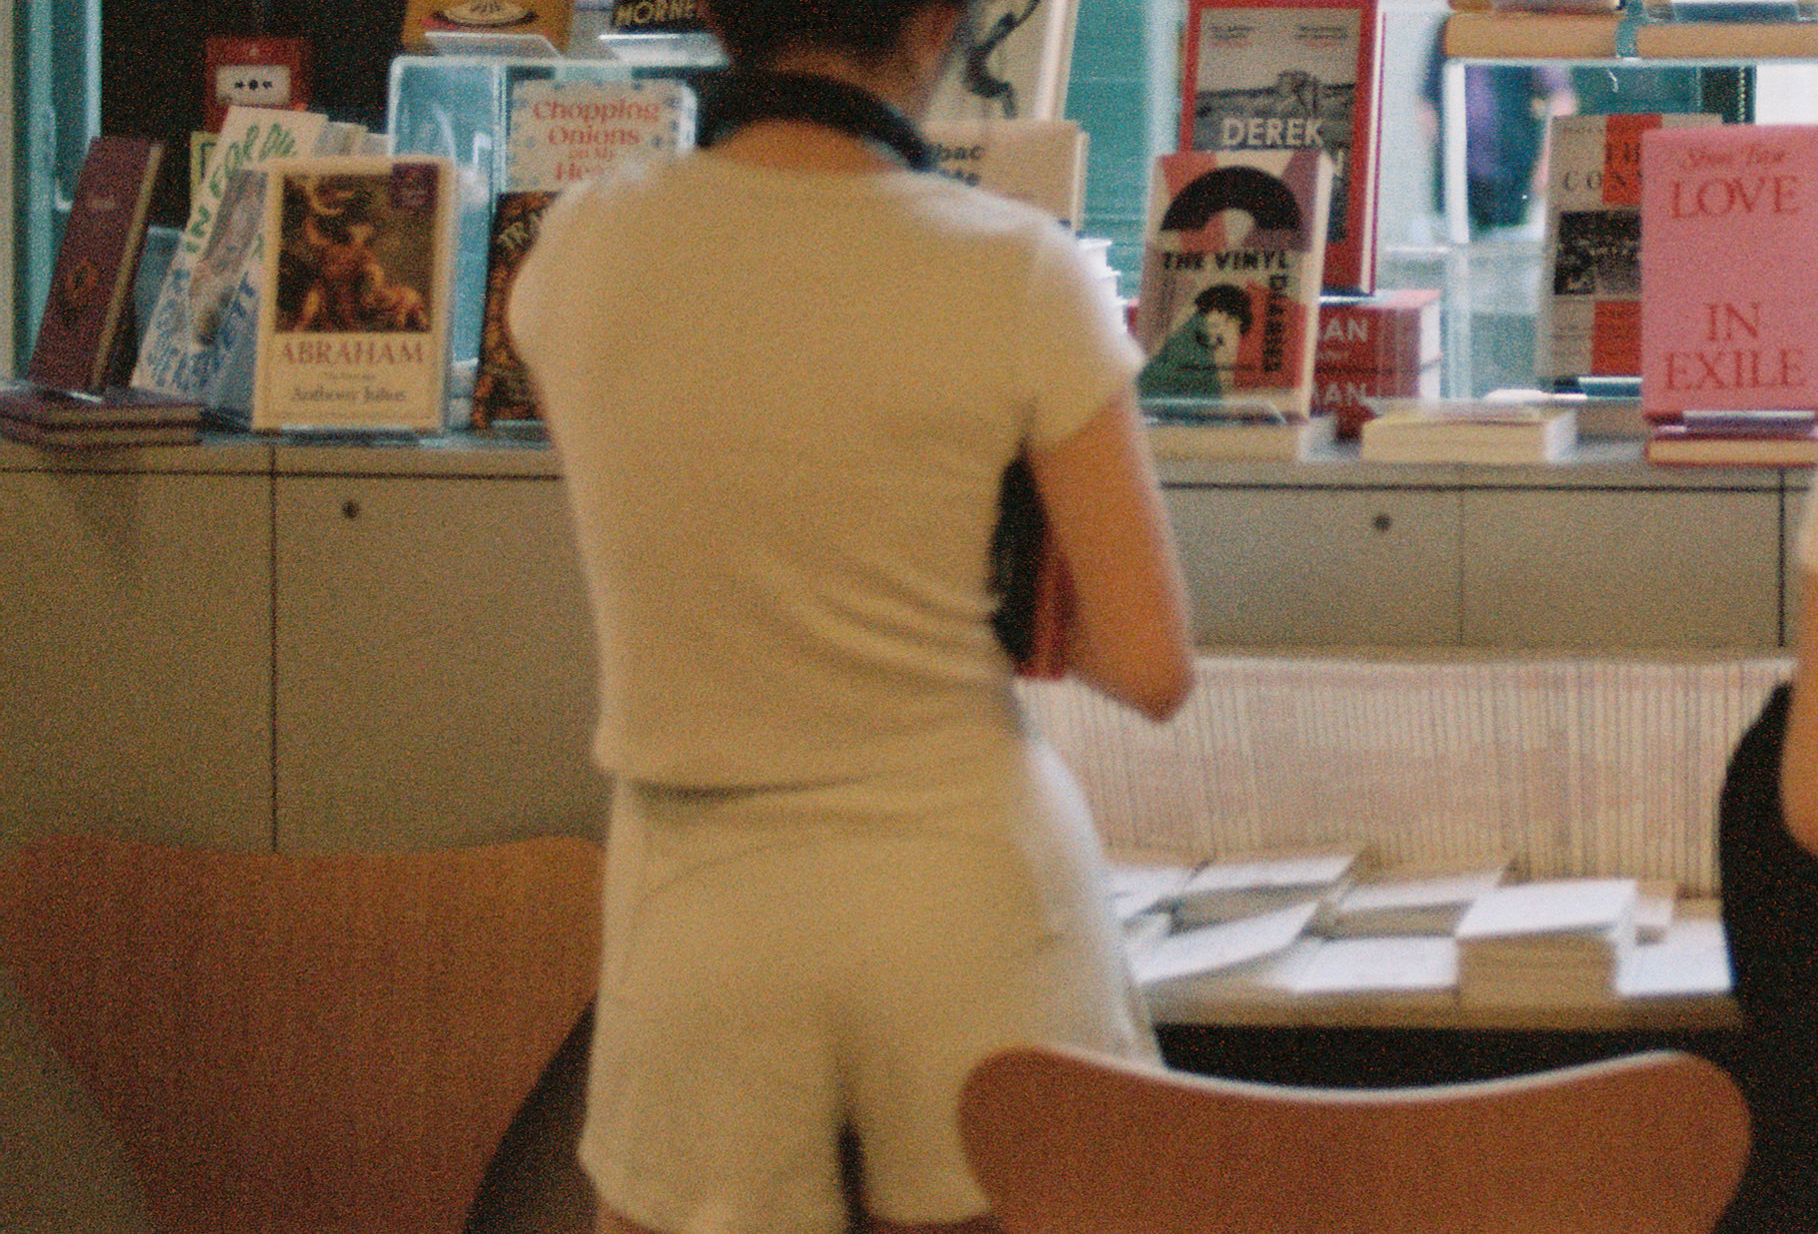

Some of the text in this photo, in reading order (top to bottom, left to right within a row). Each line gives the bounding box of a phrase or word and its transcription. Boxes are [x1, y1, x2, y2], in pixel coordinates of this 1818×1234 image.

[532, 99, 661, 124] Chopping
[547, 125, 641, 145] Onions
[1221, 117, 1324, 147] DEREK
[1671, 175, 1800, 220] LOVE
[1215, 251, 1288, 269] VINYL
[1702, 302, 1761, 342] IN
[283, 341, 424, 364] ABRAHAM
[1663, 348, 1807, 391] EXILE
